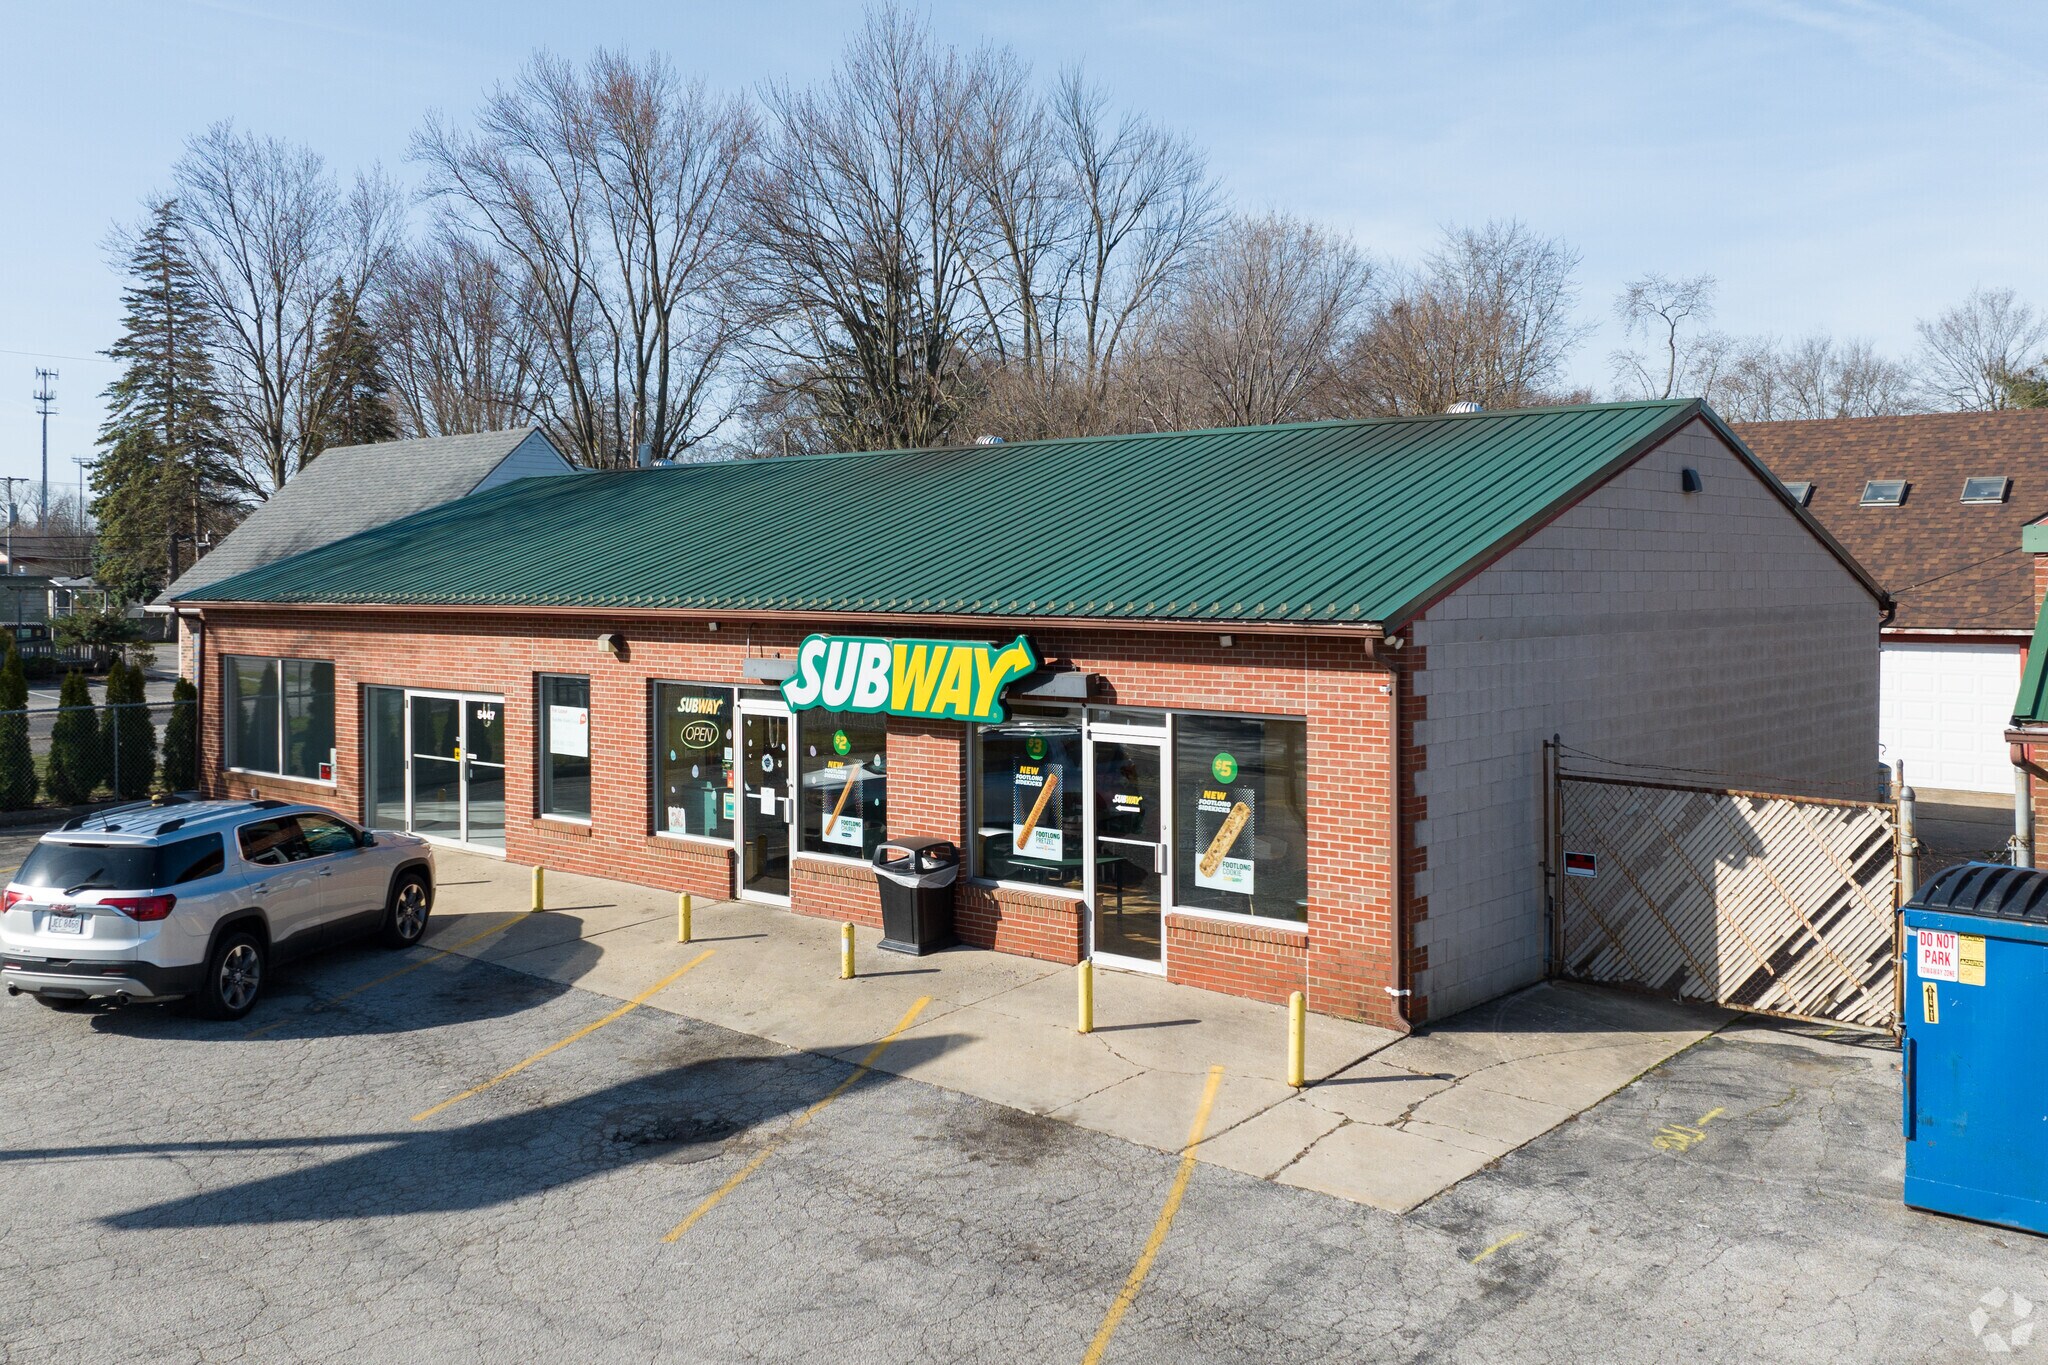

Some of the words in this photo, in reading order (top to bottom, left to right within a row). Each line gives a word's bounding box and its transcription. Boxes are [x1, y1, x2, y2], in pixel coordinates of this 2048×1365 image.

[783, 640, 1031, 717] SUBWAY
[677, 697, 723, 715] SUBWAY
[686, 726, 714, 742] OPEN
[835, 735, 847, 750] $2
[1028, 738, 1042, 753] $3
[828, 760, 844, 768] NEW
[1215, 759, 1232, 777] $5
[1020, 766, 1039, 775] NEW
[1015, 774, 1043, 782] FOOTLONG
[1112, 794, 1143, 805] SUBWAY
[1203, 790, 1227, 800] NEW
[1198, 799, 1231, 807] FOOTLONG
[841, 819, 861, 827] FOOTLONG
[1036, 831, 1060, 840] FOOTLONG
[1036, 837, 1054, 845] PRETZEL
[1222, 861, 1251, 871] FOOTLONG
[1222, 869, 1242, 877] COOKIE
[1920, 932, 1933, 947] DO
[1937, 934, 1955, 949] NOT
[1925, 950, 1951, 966] PARK
